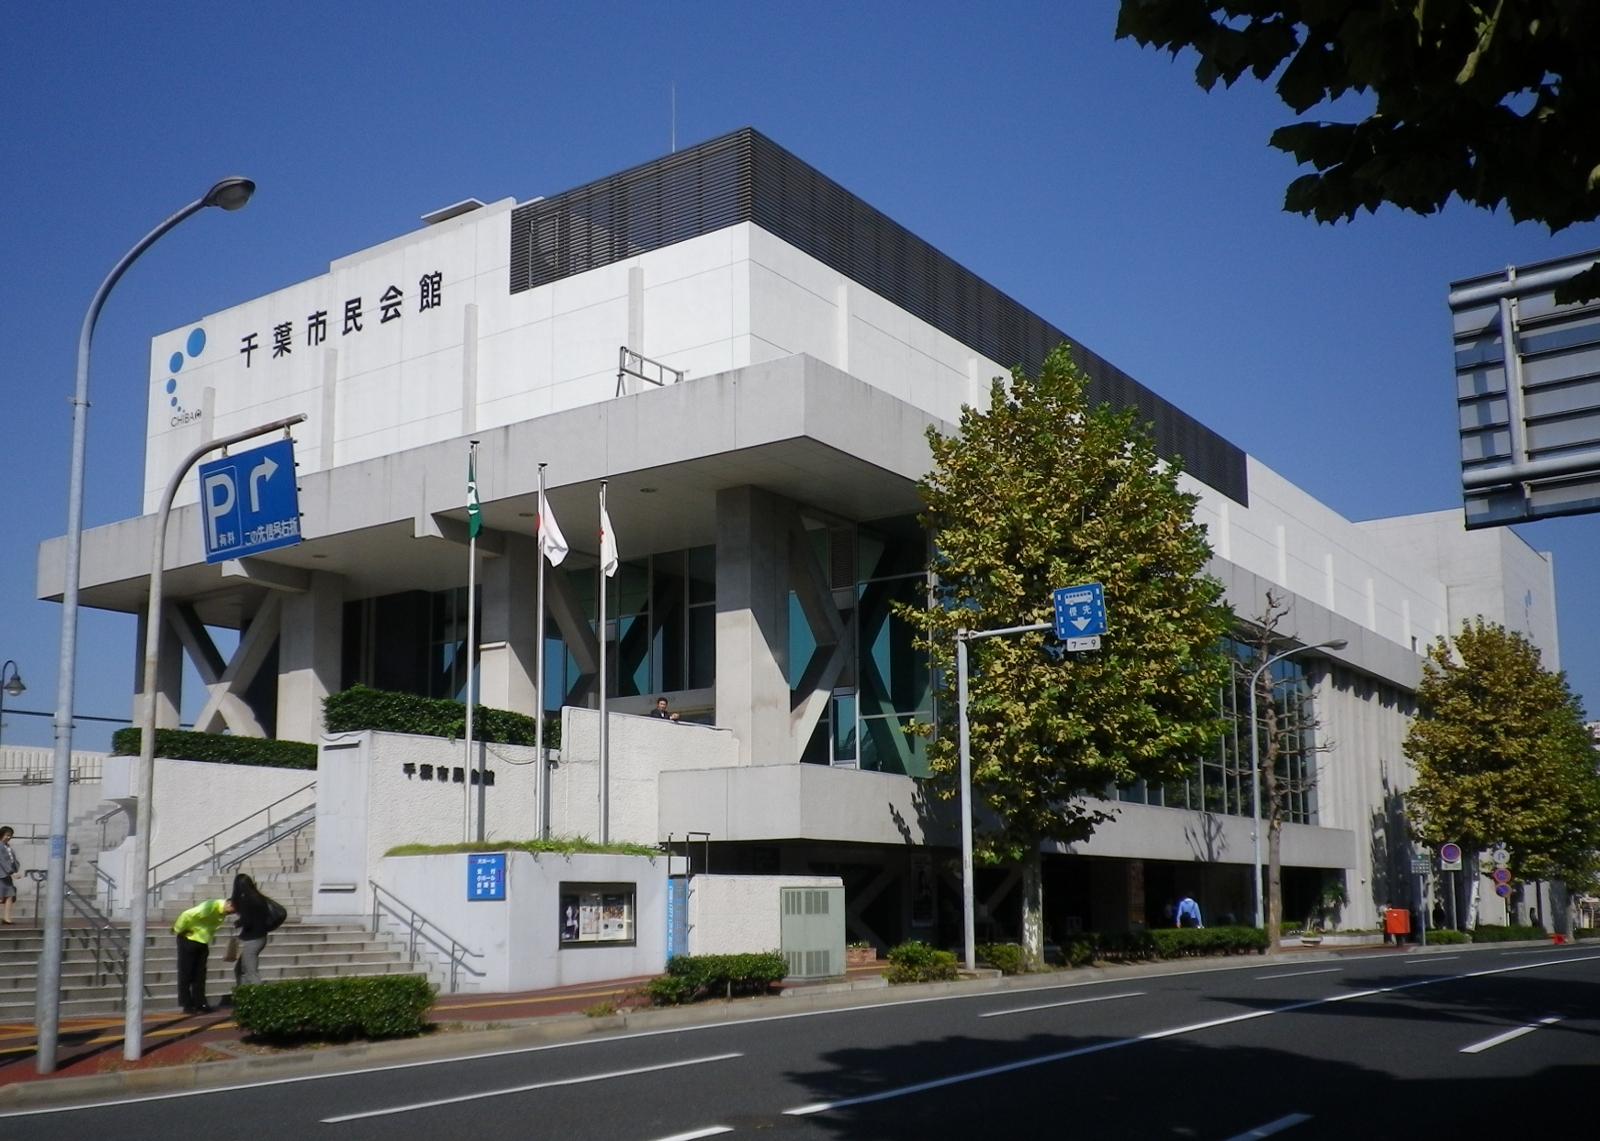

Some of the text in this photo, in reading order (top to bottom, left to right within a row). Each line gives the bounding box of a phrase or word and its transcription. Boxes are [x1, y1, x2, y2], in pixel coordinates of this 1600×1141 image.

[240, 270, 443, 368] 千葉市民会館
[205, 473, 236, 550] P
